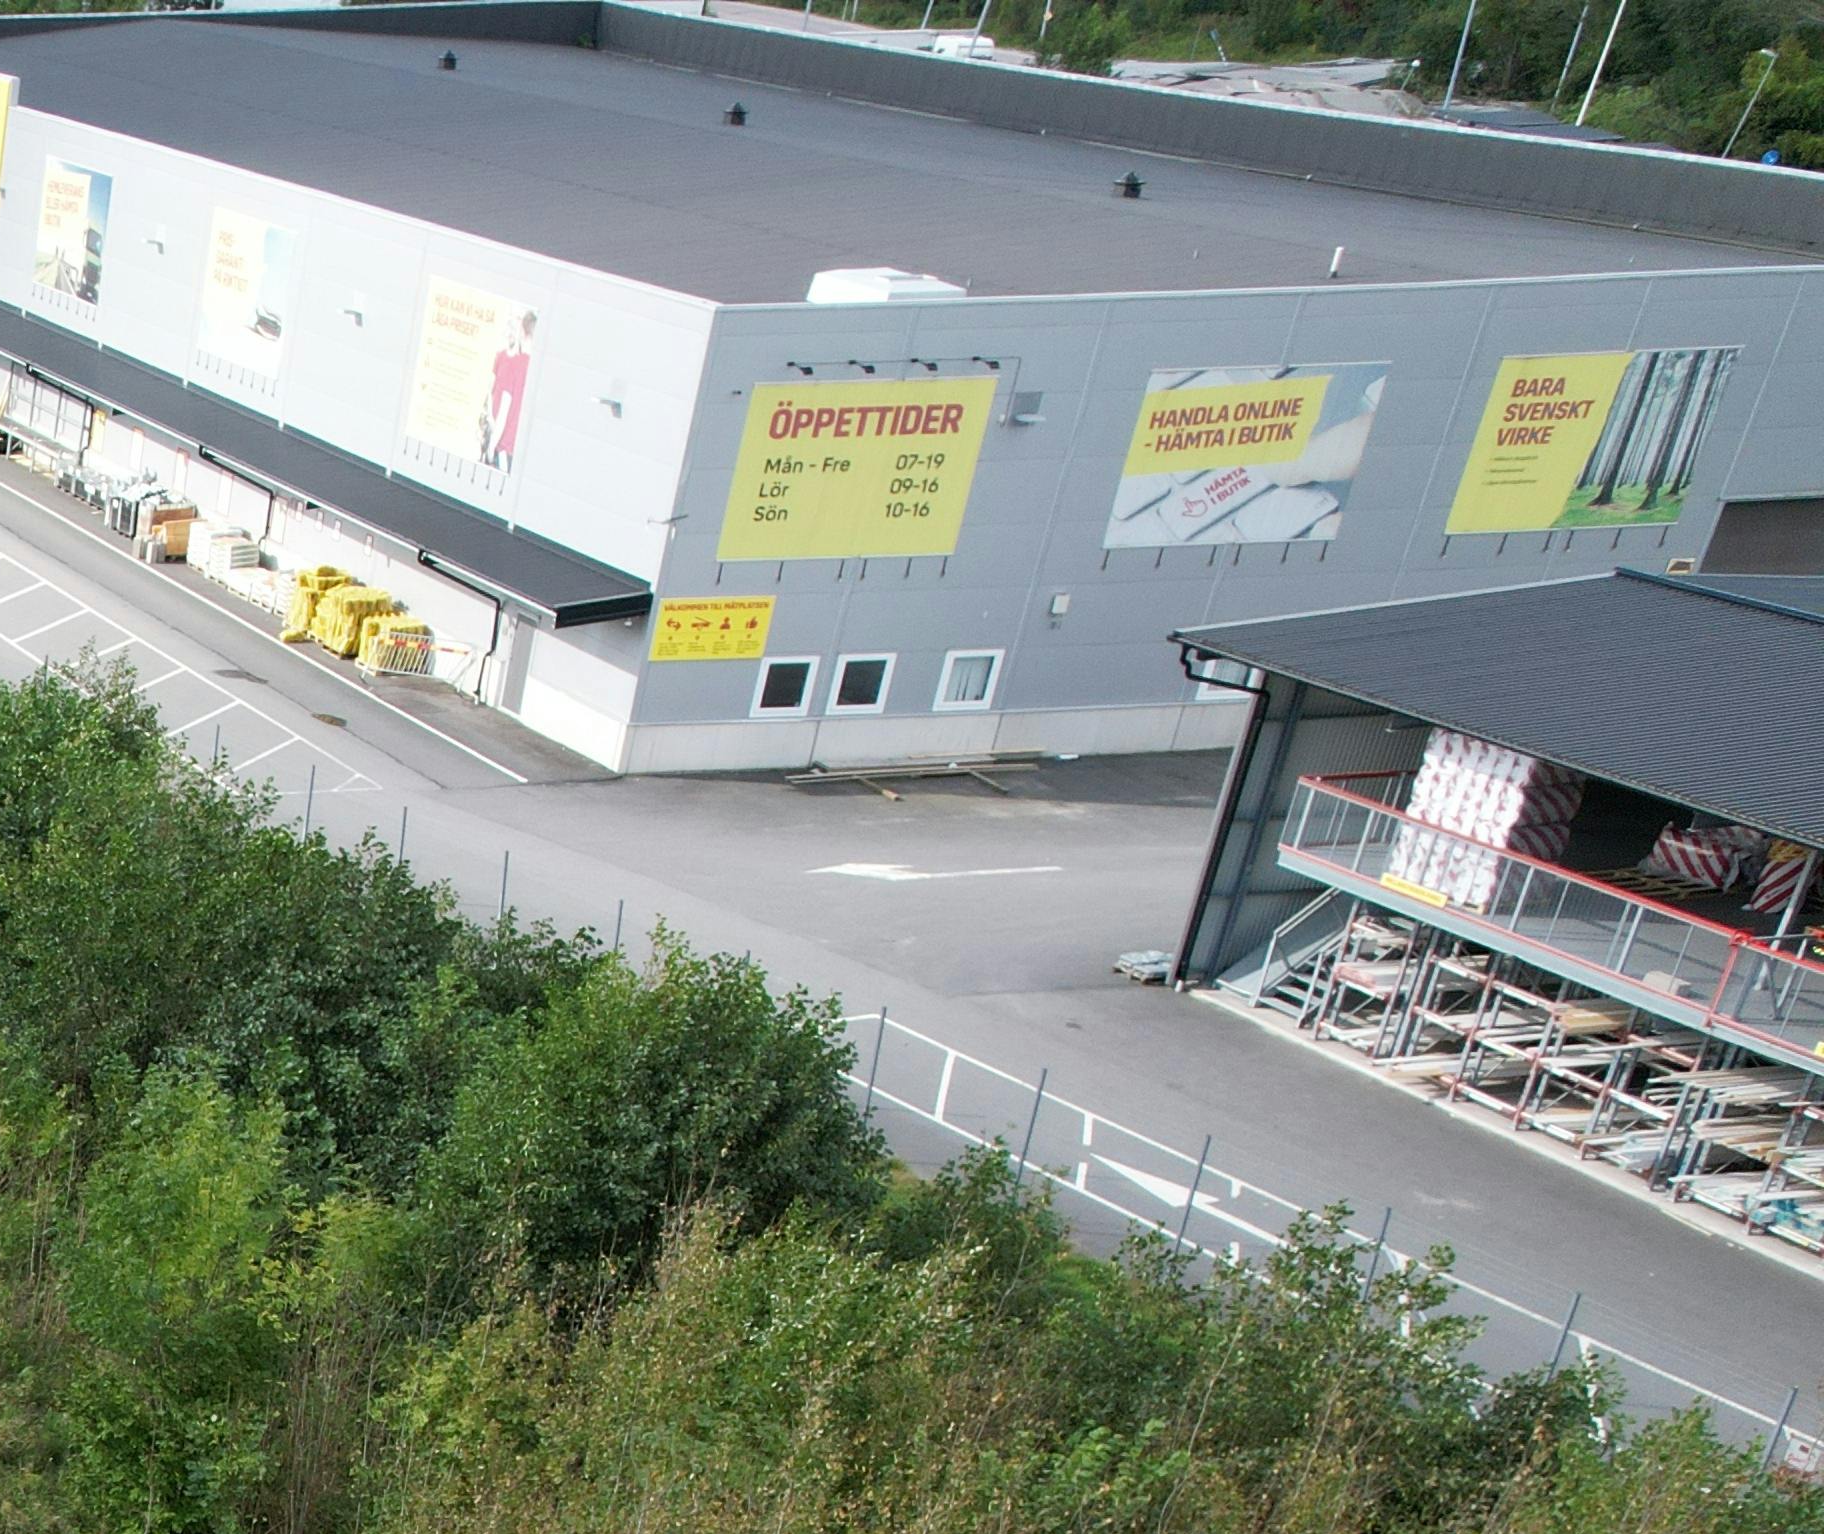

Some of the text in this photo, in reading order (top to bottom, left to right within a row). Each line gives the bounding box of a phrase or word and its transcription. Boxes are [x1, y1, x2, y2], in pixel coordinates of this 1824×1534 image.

[1510, 377, 1565, 397] BARA
[769, 400, 964, 439] ÖPPETTIDER
[1149, 397, 1304, 429] HANDLA ONLINE
[1503, 400, 1595, 422] SVENSKT
[1155, 428, 1224, 452] HÄMTA
[1228, 429, 1236, 446] I
[1238, 422, 1297, 445] BUTIK
[1497, 426, 1555, 446] VIRKE
[764, 455, 803, 474] Mån
[822, 457, 850, 473] Fre
[895, 453, 945, 471] 07-19
[759, 477, 939, 498] Lör 09-16
[1204, 466, 1247, 496] HÄMTA
[1218, 478, 1251, 502] BUTIK
[753, 502, 930, 522] Sön 10-16
